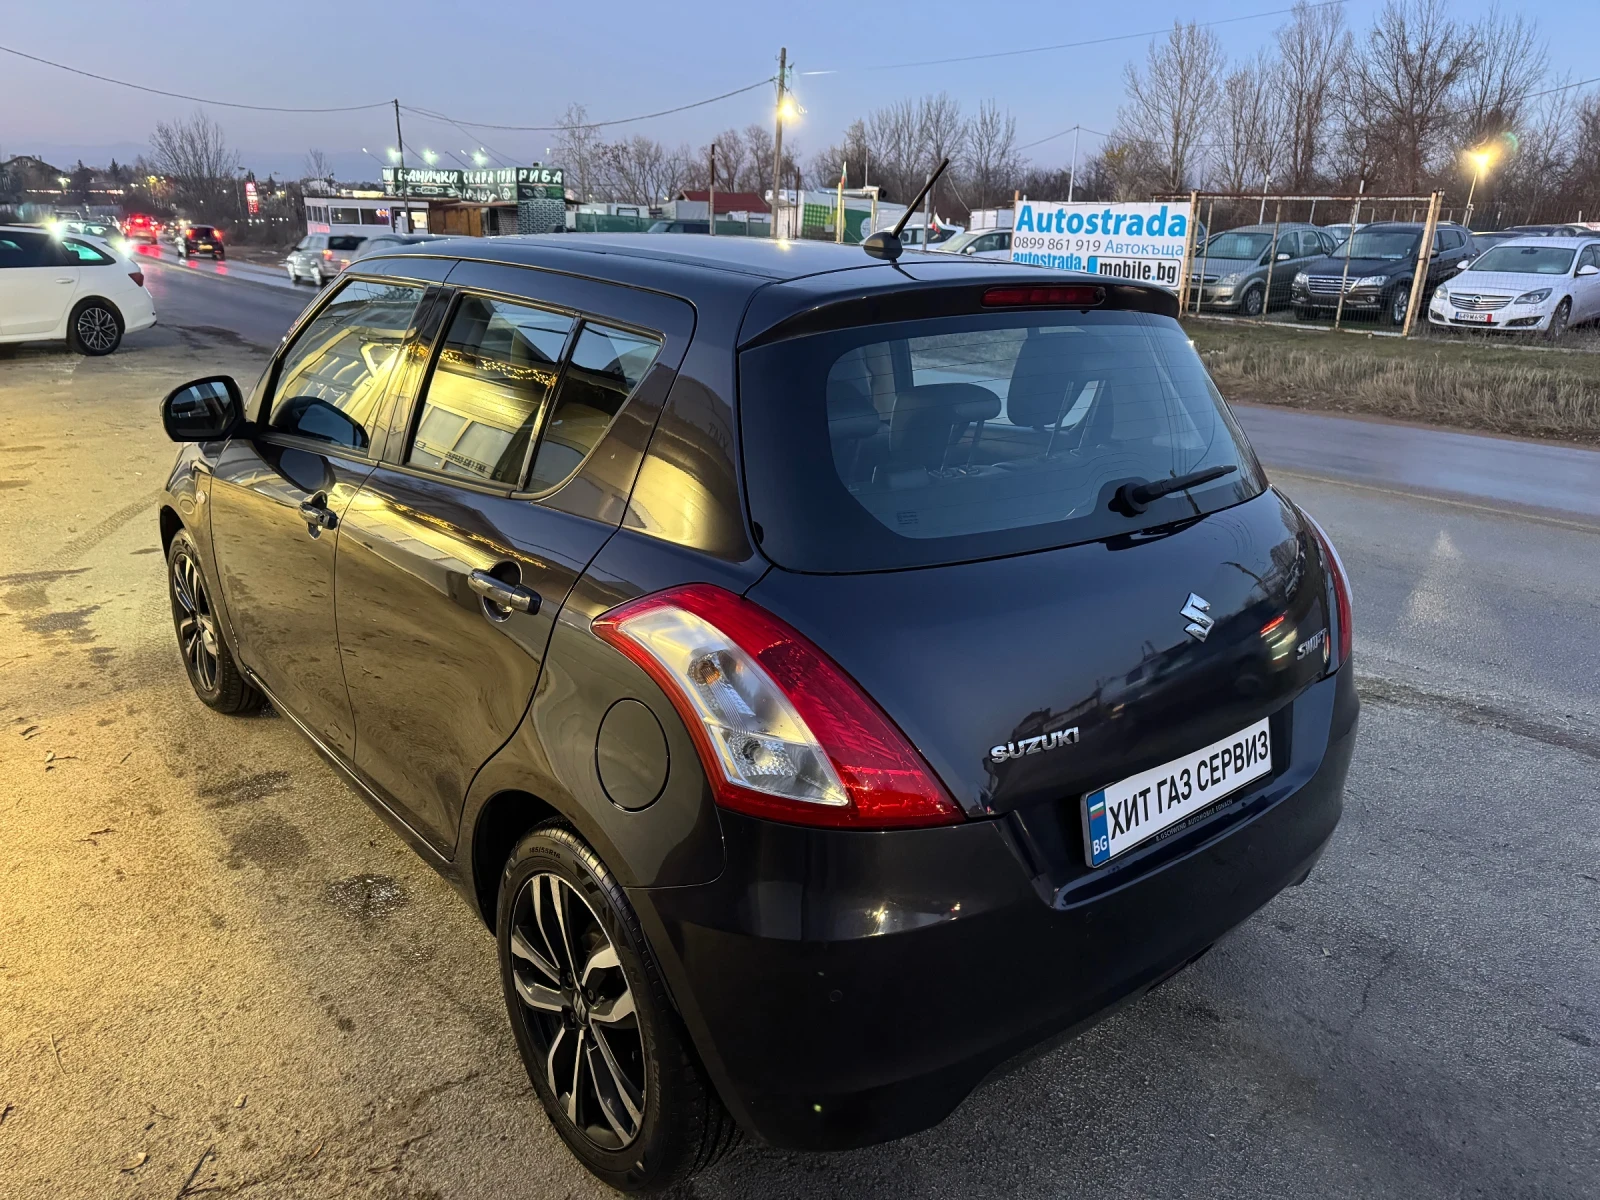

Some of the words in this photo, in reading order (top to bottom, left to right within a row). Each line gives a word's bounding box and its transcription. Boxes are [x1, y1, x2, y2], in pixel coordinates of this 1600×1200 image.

[398, 169, 458, 184] БАНИЧКИ
[463, 171, 493, 184] СКАРА
[518, 169, 562, 183] РИБА
[1016, 205, 1187, 237] Autostrada
[1014, 236, 1044, 249] 0899
[1047, 238, 1070, 250] 861
[1075, 240, 1101, 252] 919
[1104, 239, 1184, 256] Автокъща
[1099, 260, 1177, 284] mobile.bg
[989, 726, 1081, 764] SUZUKI
[1108, 787, 1151, 841] ХИТ
[1156, 768, 1192, 815] ГАЗ
[1196, 731, 1268, 791] СЕРВИЗ
[1093, 835, 1108, 856] BG
